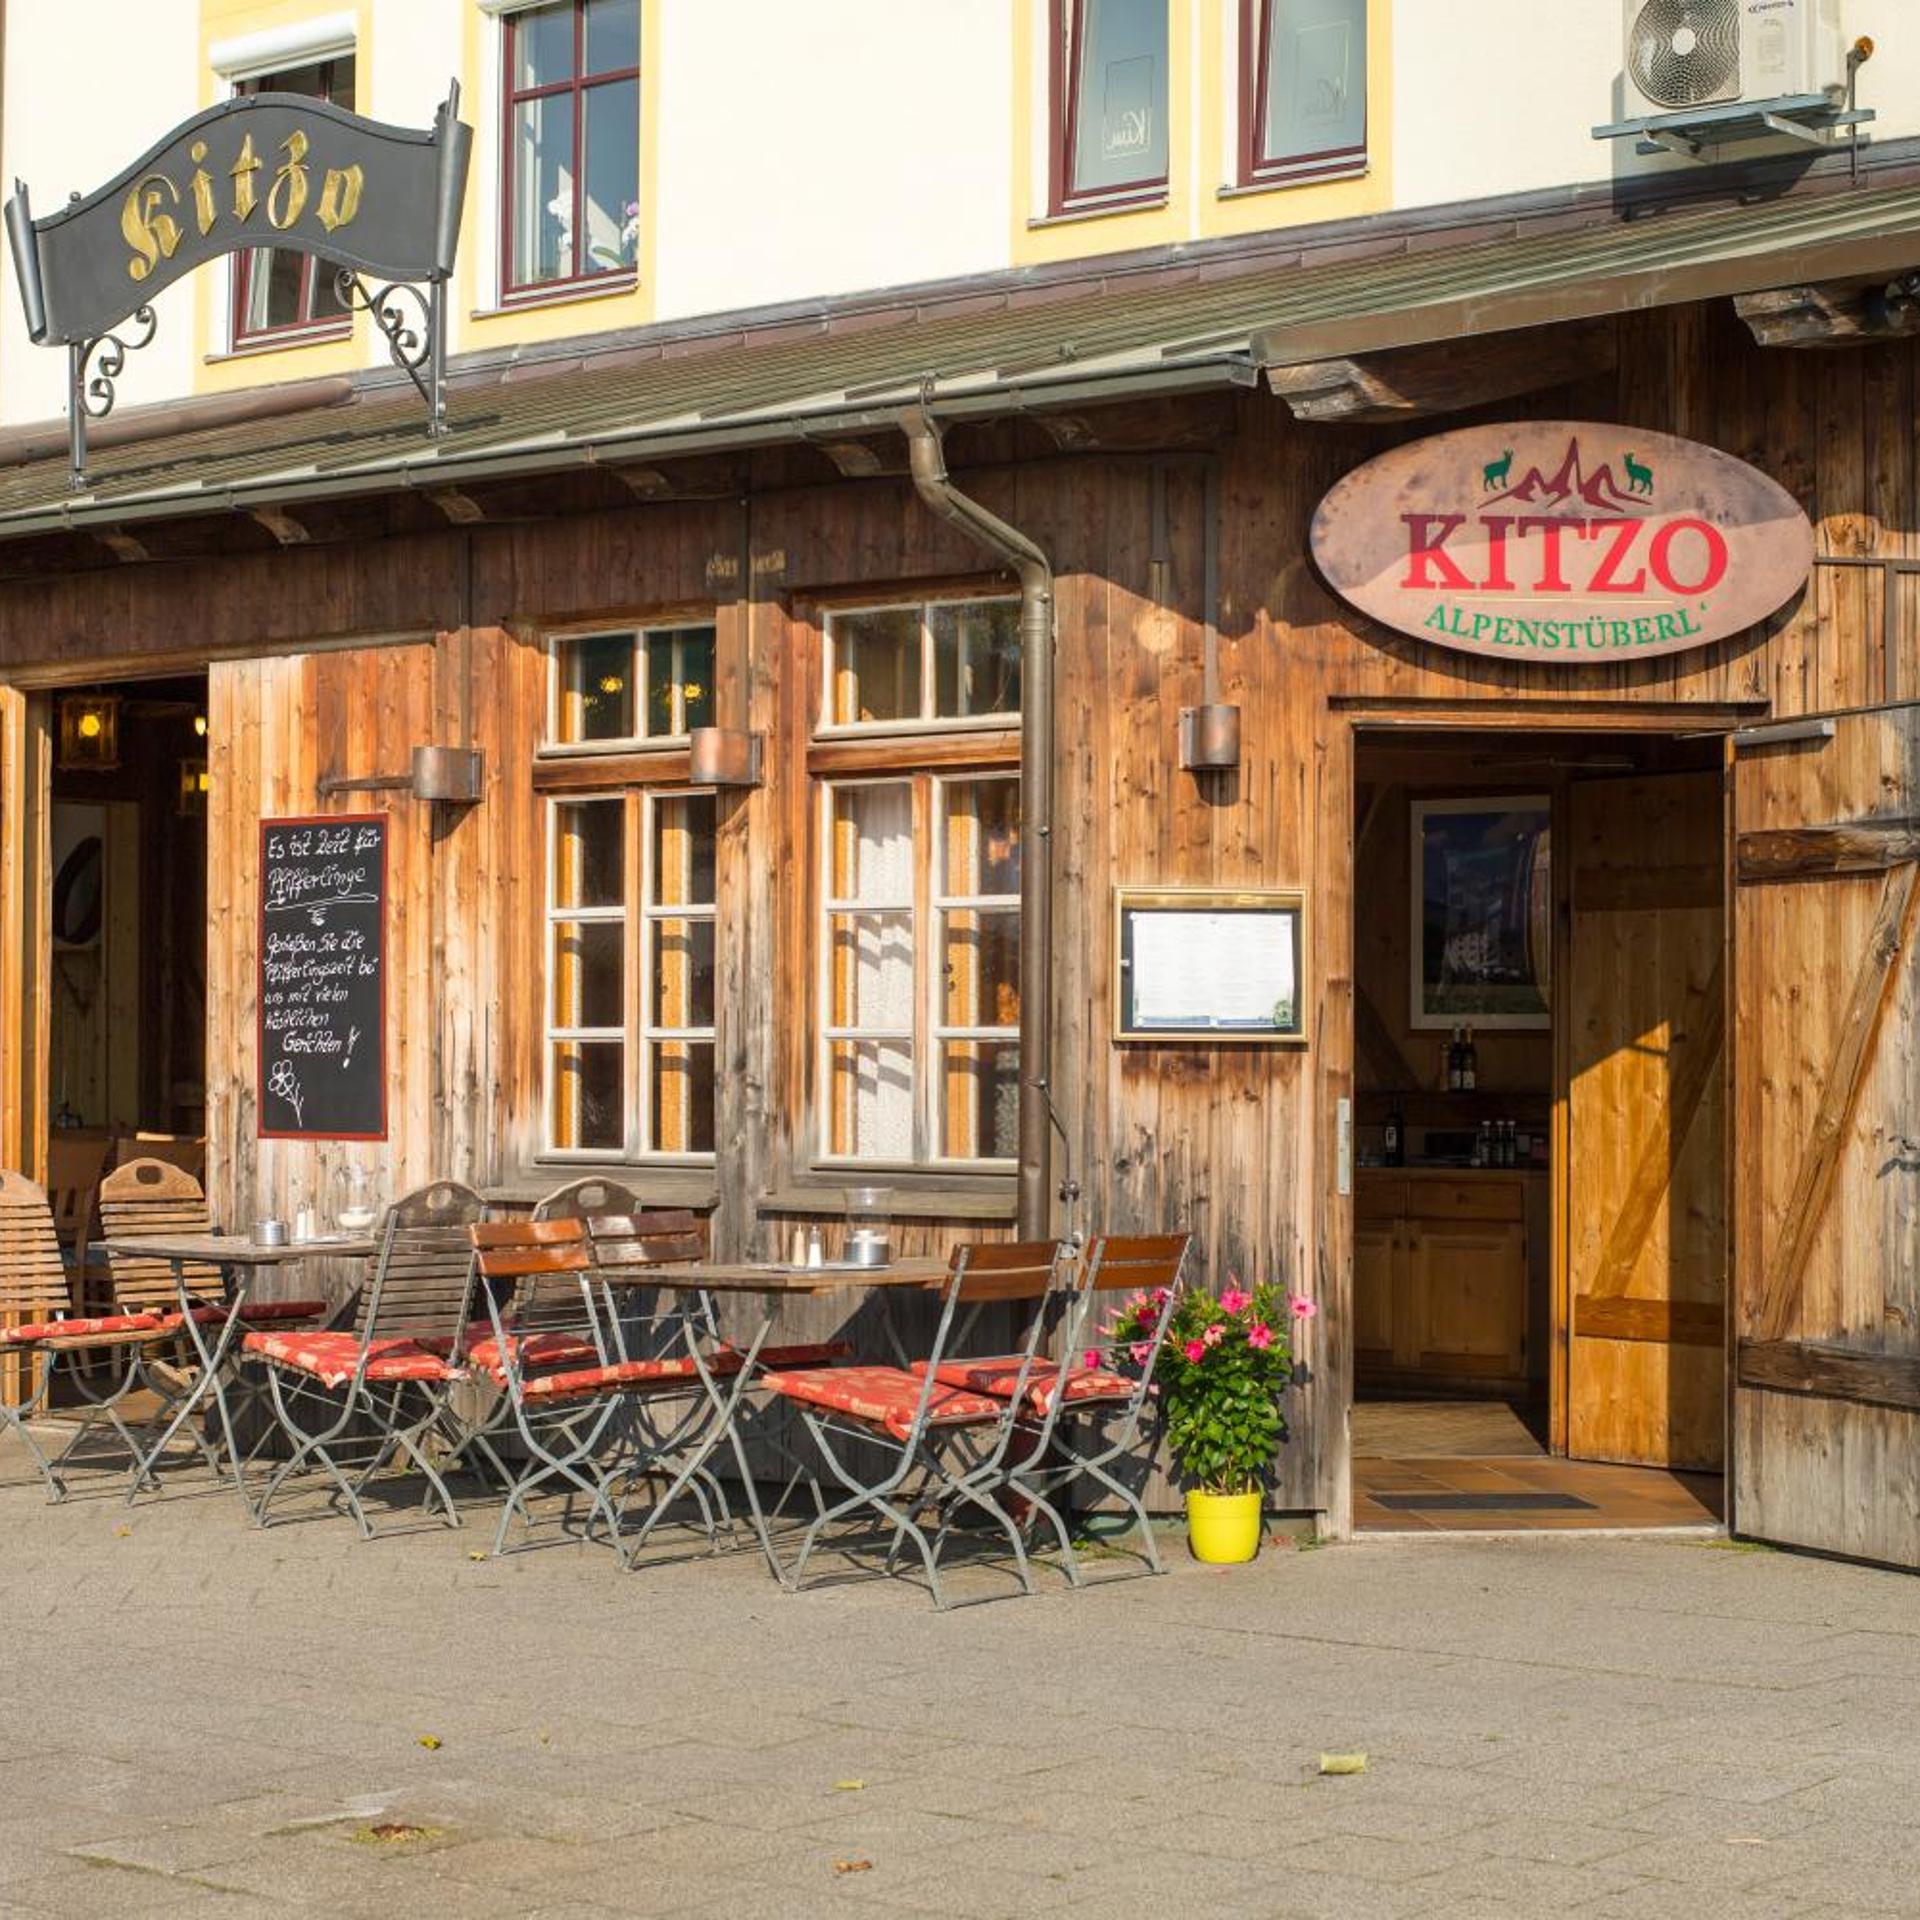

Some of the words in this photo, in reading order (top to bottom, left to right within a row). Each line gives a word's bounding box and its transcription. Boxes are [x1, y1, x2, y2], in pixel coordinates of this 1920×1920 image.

[121, 129, 364, 281] Kitzo
[1401, 514, 1728, 595] KITZO
[268, 836, 285, 859] Es
[289, 830, 312, 857] ist
[314, 828, 351, 855] Zeit
[268, 864, 366, 904] Pfifferlinge
[316, 933, 339, 953] Sie
[341, 931, 365, 950] die
[288, 983, 312, 1003] mit
[316, 982, 349, 1003] vielen
